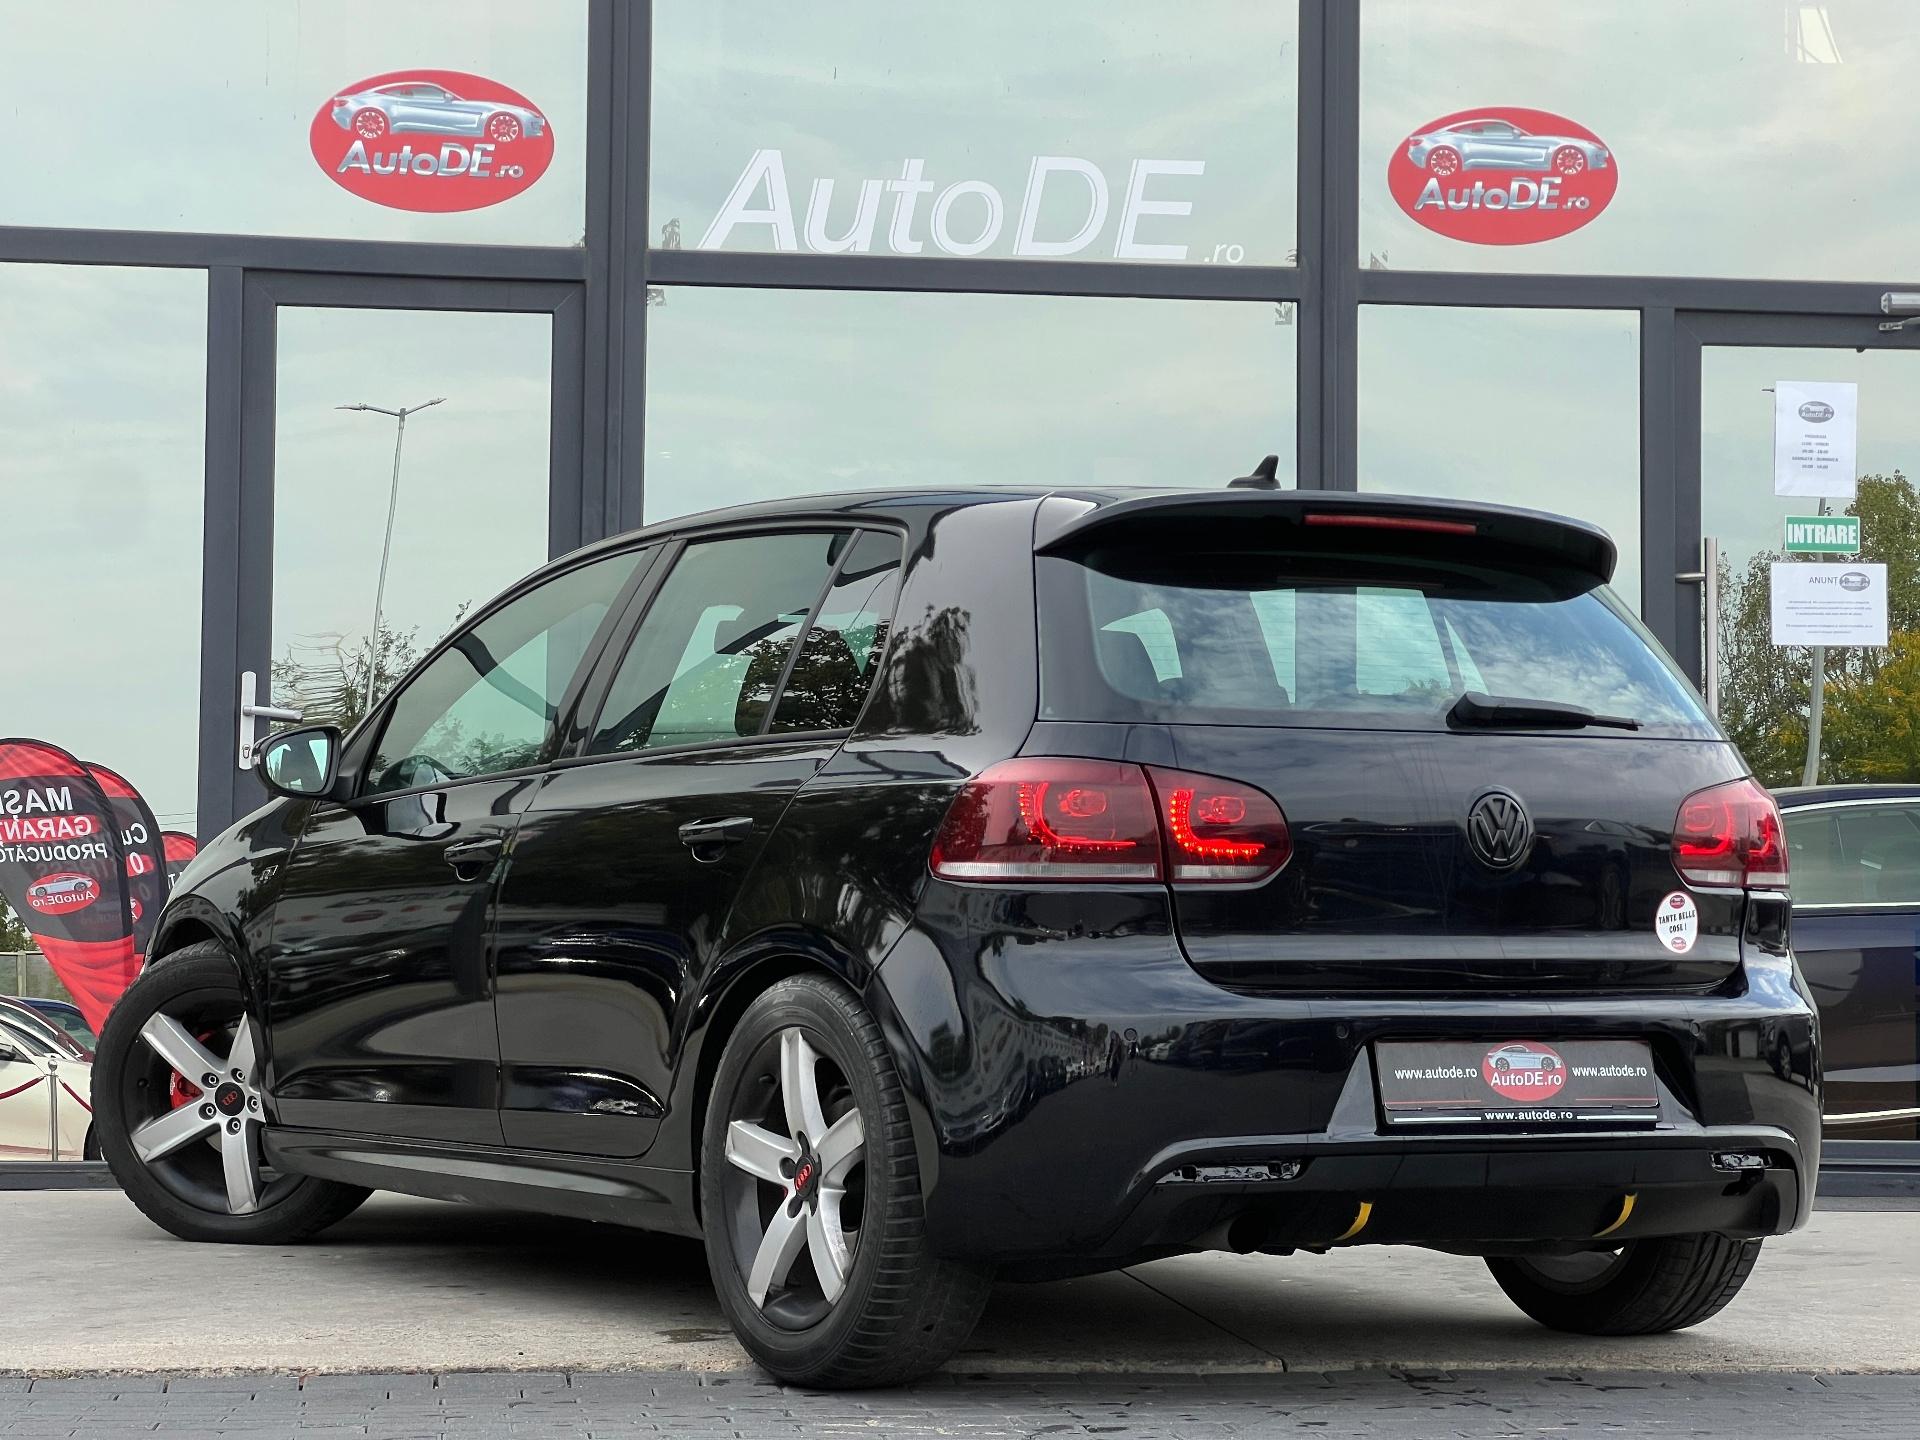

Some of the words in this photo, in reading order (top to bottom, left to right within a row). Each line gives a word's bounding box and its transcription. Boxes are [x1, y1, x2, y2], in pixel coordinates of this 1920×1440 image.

[1787, 523, 1857, 545] INTRARE
[1658, 913, 1677, 925] TANTE
[1678, 909, 1696, 921] BELLE
[1394, 1065, 1478, 1080] www.autode.ro
[1490, 1072, 1562, 1087] AutoDE.ro
[1572, 1066, 1648, 1078] www.autode.ro
[1484, 1110, 1574, 1121] www.autode.ro
